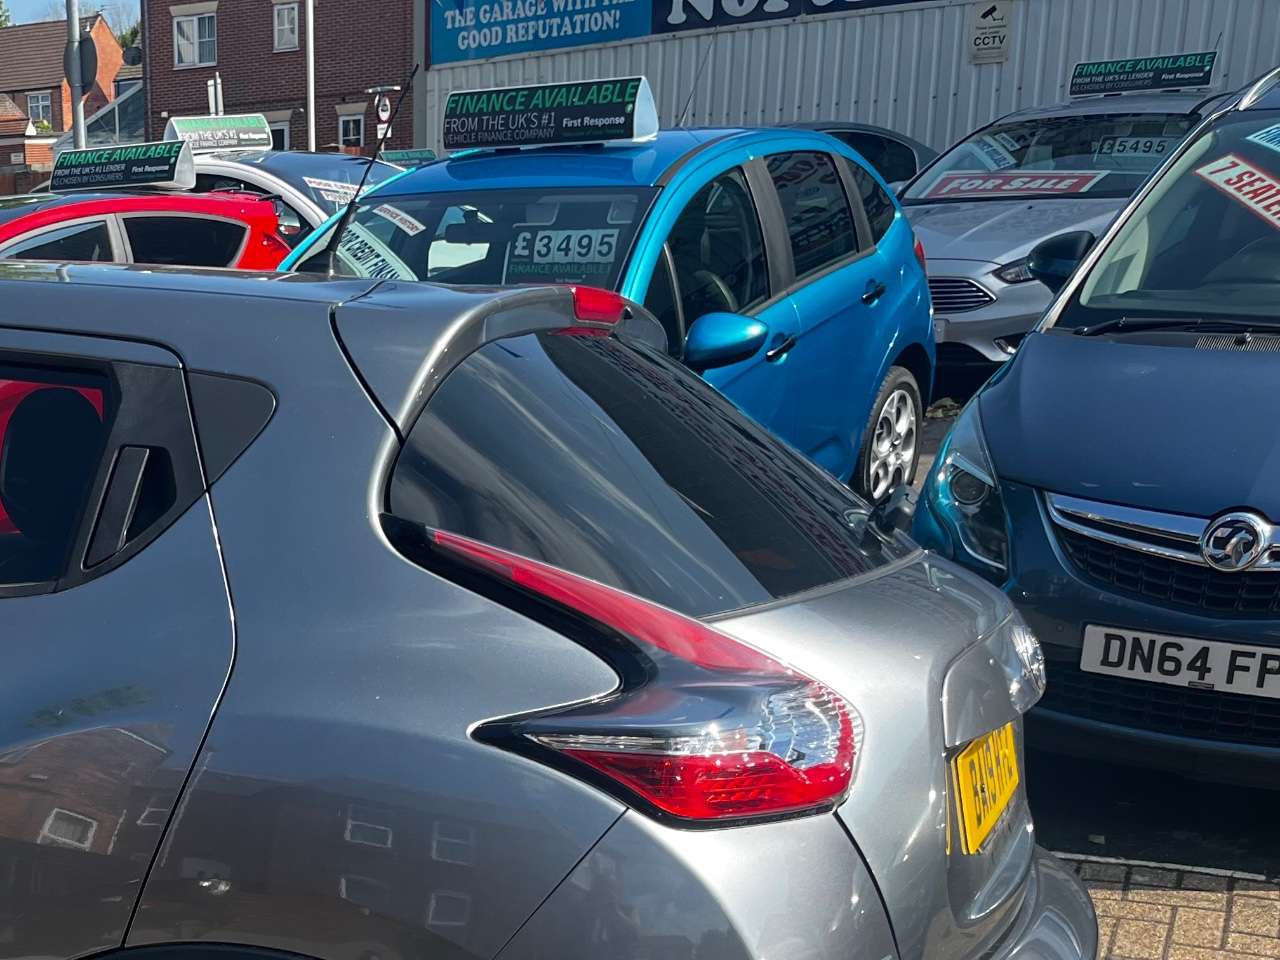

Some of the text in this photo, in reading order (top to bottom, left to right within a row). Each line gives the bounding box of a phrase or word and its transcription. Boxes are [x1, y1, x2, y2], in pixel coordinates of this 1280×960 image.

[444, 7, 475, 29] THE
[479, 0, 548, 23] GARAGE
[458, 10, 620, 50] GOOD REPUTATION!
[973, 35, 1006, 46] CCTV
[1075, 54, 1213, 76] FINANCE AVAILABLE
[446, 82, 639, 115] FINANCE AVAILABLE
[445, 112, 556, 132] FROM THE UK'S #1
[562, 115, 625, 128] First Response
[445, 132, 477, 145] VEHICLE
[478, 130, 512, 143] FINANCE
[514, 128, 555, 140] COMPANY
[57, 143, 181, 167] FINANCE AVAILABLE
[1207, 161, 1240, 175] 7
[938, 177, 1079, 194] FOR SALE
[514, 232, 615, 258] £3495
[1100, 633, 1212, 681] DN64
